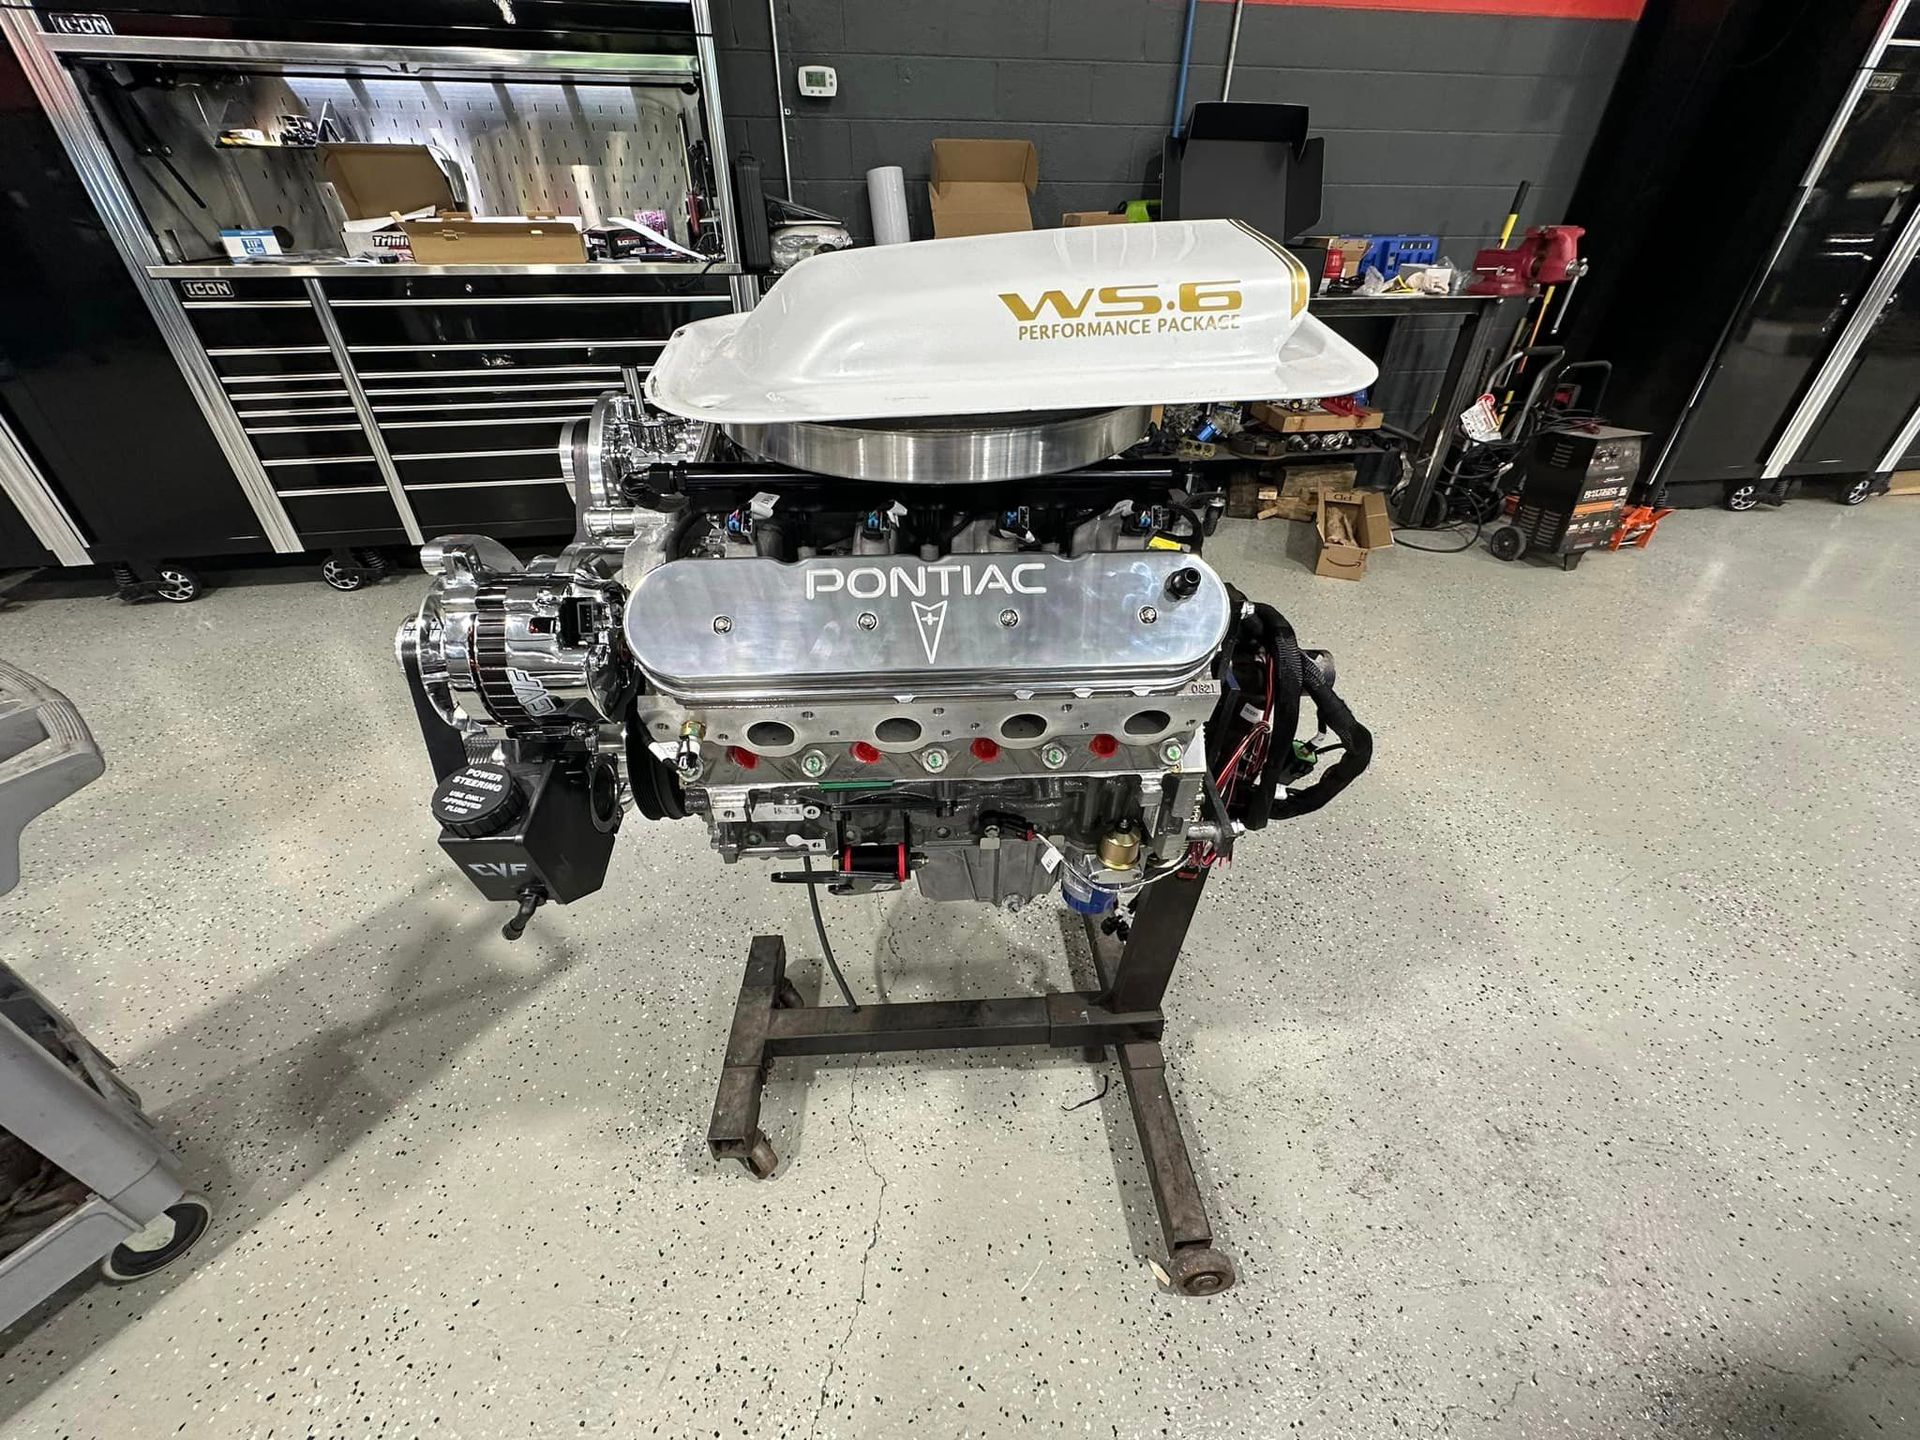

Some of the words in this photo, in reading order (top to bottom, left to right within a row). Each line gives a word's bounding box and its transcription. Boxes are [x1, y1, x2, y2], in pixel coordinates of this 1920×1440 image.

[57, 17, 110, 34] ICON
[186, 283, 230, 295] ICON
[998, 280, 1243, 321] WS.6
[1018, 318, 1151, 341] PERFORMANCE
[1157, 314, 1241, 333] PACKAGE
[806, 563, 1047, 600] PONTIAC
[506, 668, 557, 717] CVF
[466, 768, 503, 782] POWER
[452, 776, 503, 792] STEERING
[441, 797, 482, 809] APPROVED
[449, 790, 466, 799] USE
[464, 793, 486, 802] ONLY
[444, 805, 468, 814] FLUID
[467, 863, 528, 878] CVF
